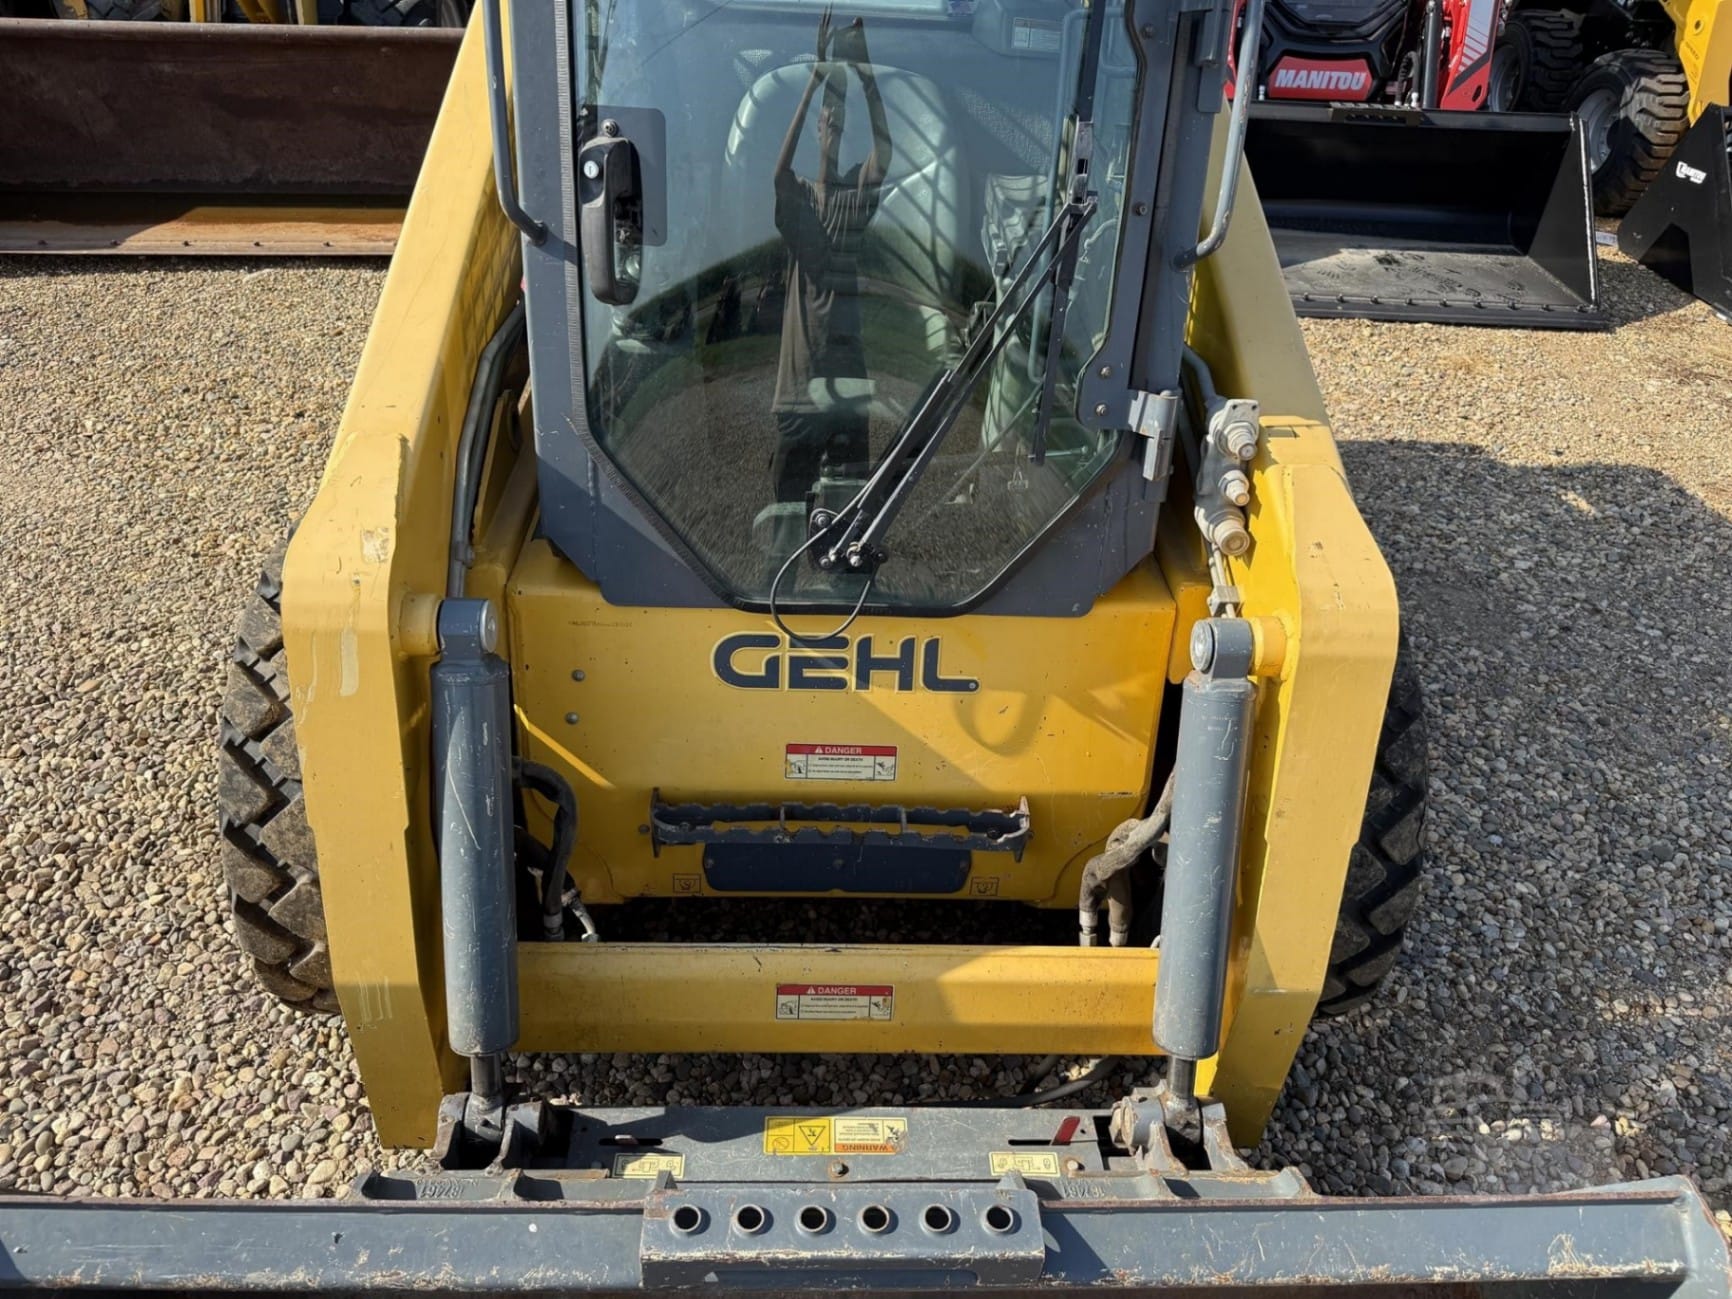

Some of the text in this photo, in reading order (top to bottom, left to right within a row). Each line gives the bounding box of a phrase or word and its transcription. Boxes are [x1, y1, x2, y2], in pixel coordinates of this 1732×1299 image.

[1275, 69, 1367, 90] MANITOU
[711, 632, 980, 692] GEHL
[824, 746, 862, 755] DANGER
[817, 986, 857, 995] DANGER
[842, 1143, 889, 1152] WARNING
